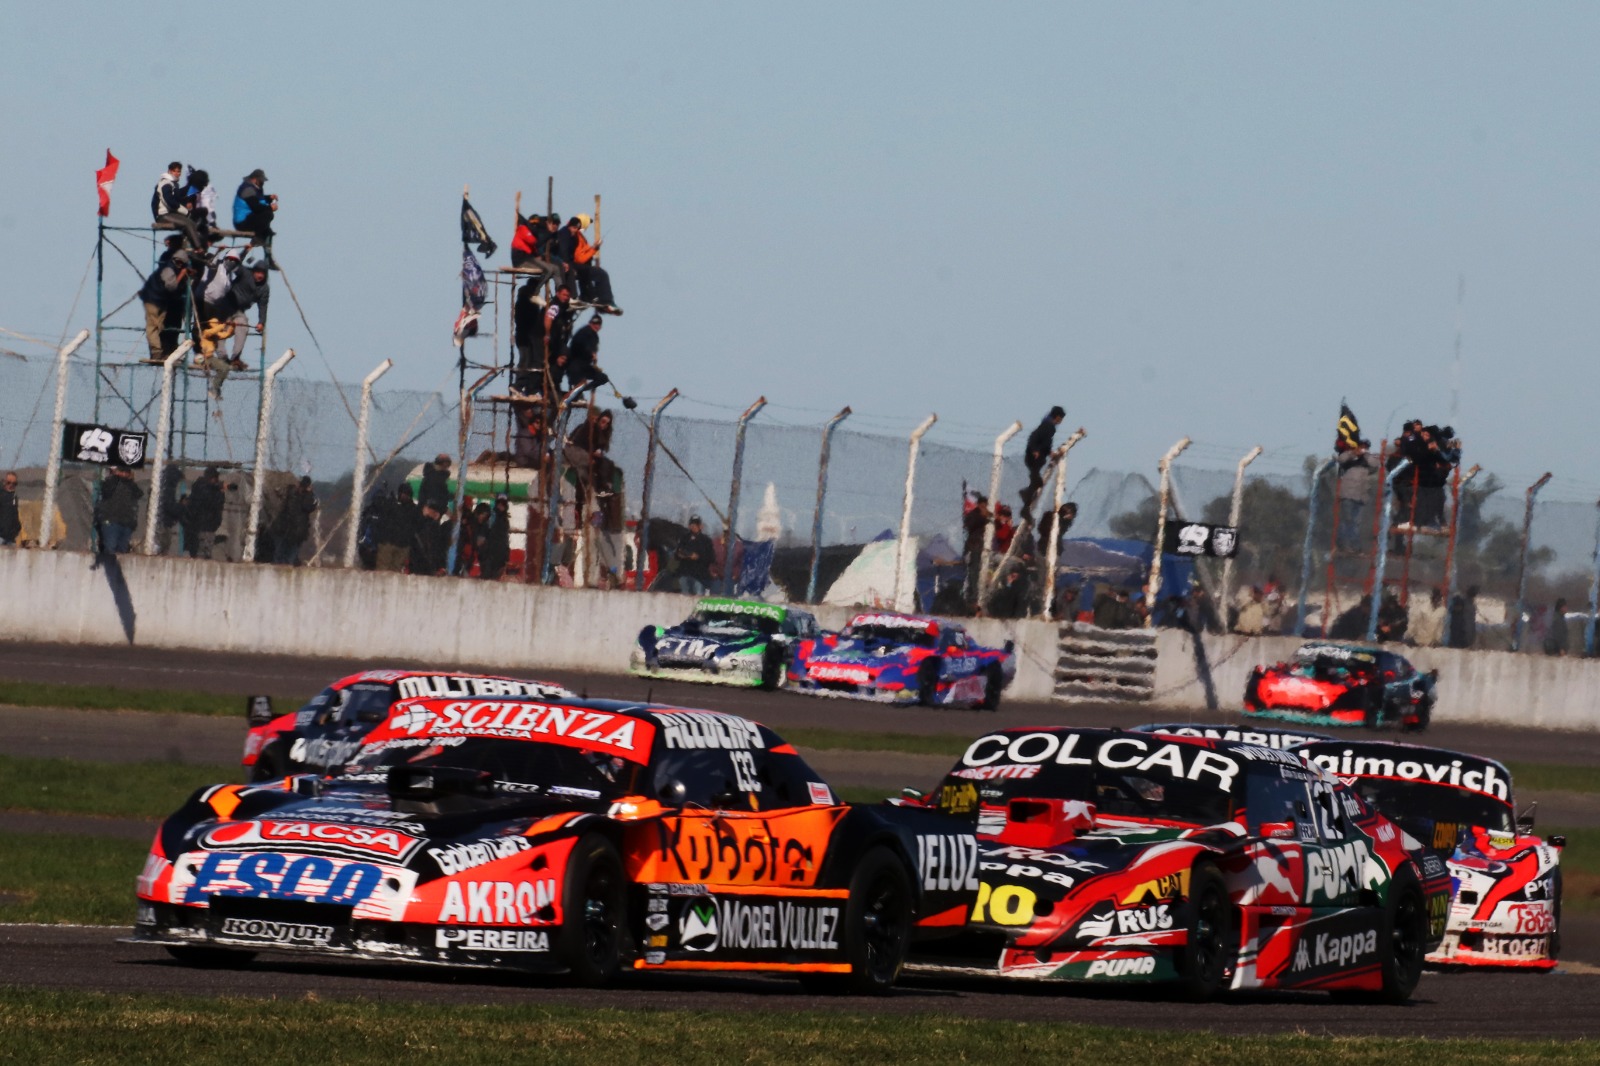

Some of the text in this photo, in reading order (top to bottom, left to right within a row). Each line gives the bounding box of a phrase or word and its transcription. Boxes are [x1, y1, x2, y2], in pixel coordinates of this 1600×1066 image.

[427, 727, 532, 739] FARMACIA
[432, 701, 636, 750] SCIENZA
[962, 733, 1239, 793] COLCAR
[269, 821, 400, 851] TACSA
[656, 815, 813, 882] Kubota
[438, 878, 556, 925] AKRON
[221, 917, 334, 943] KONJUH
[722, 900, 839, 949] MOREL VULLIEZ
[1117, 905, 1173, 933] RUS
[434, 929, 550, 949] PEREIRA
[1315, 929, 1377, 966] Kappa
[1085, 956, 1156, 978] PUMA
